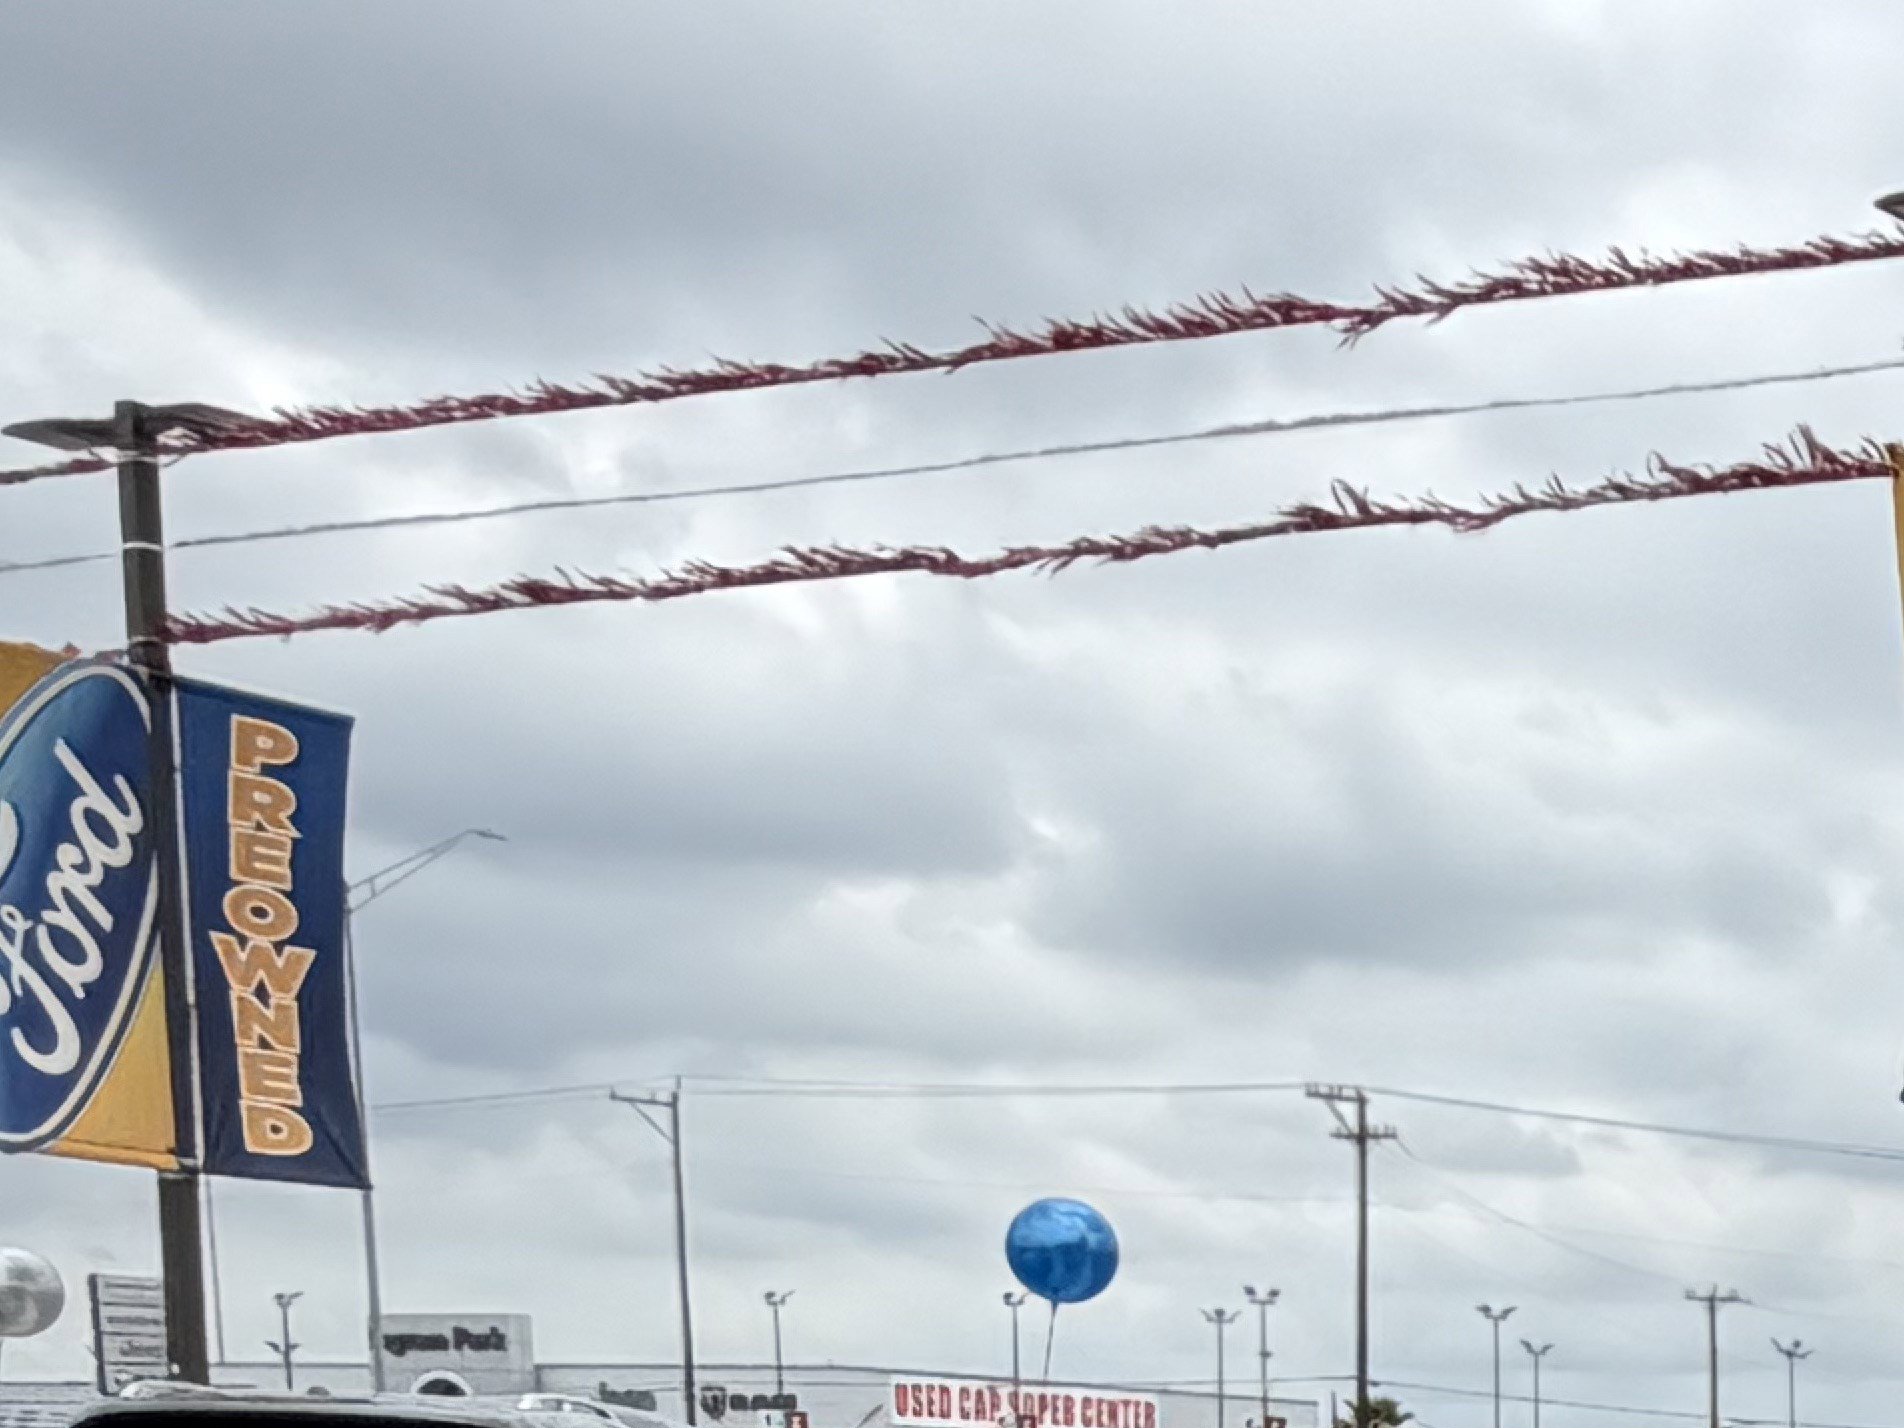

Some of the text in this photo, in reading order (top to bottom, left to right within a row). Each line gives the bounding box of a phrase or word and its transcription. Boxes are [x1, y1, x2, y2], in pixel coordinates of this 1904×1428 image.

[0, 737, 144, 1076] Ford
[209, 713, 316, 1156] PREOWNED
[894, 1383, 951, 1419] USED
[958, 1385, 1001, 1422] CAR
